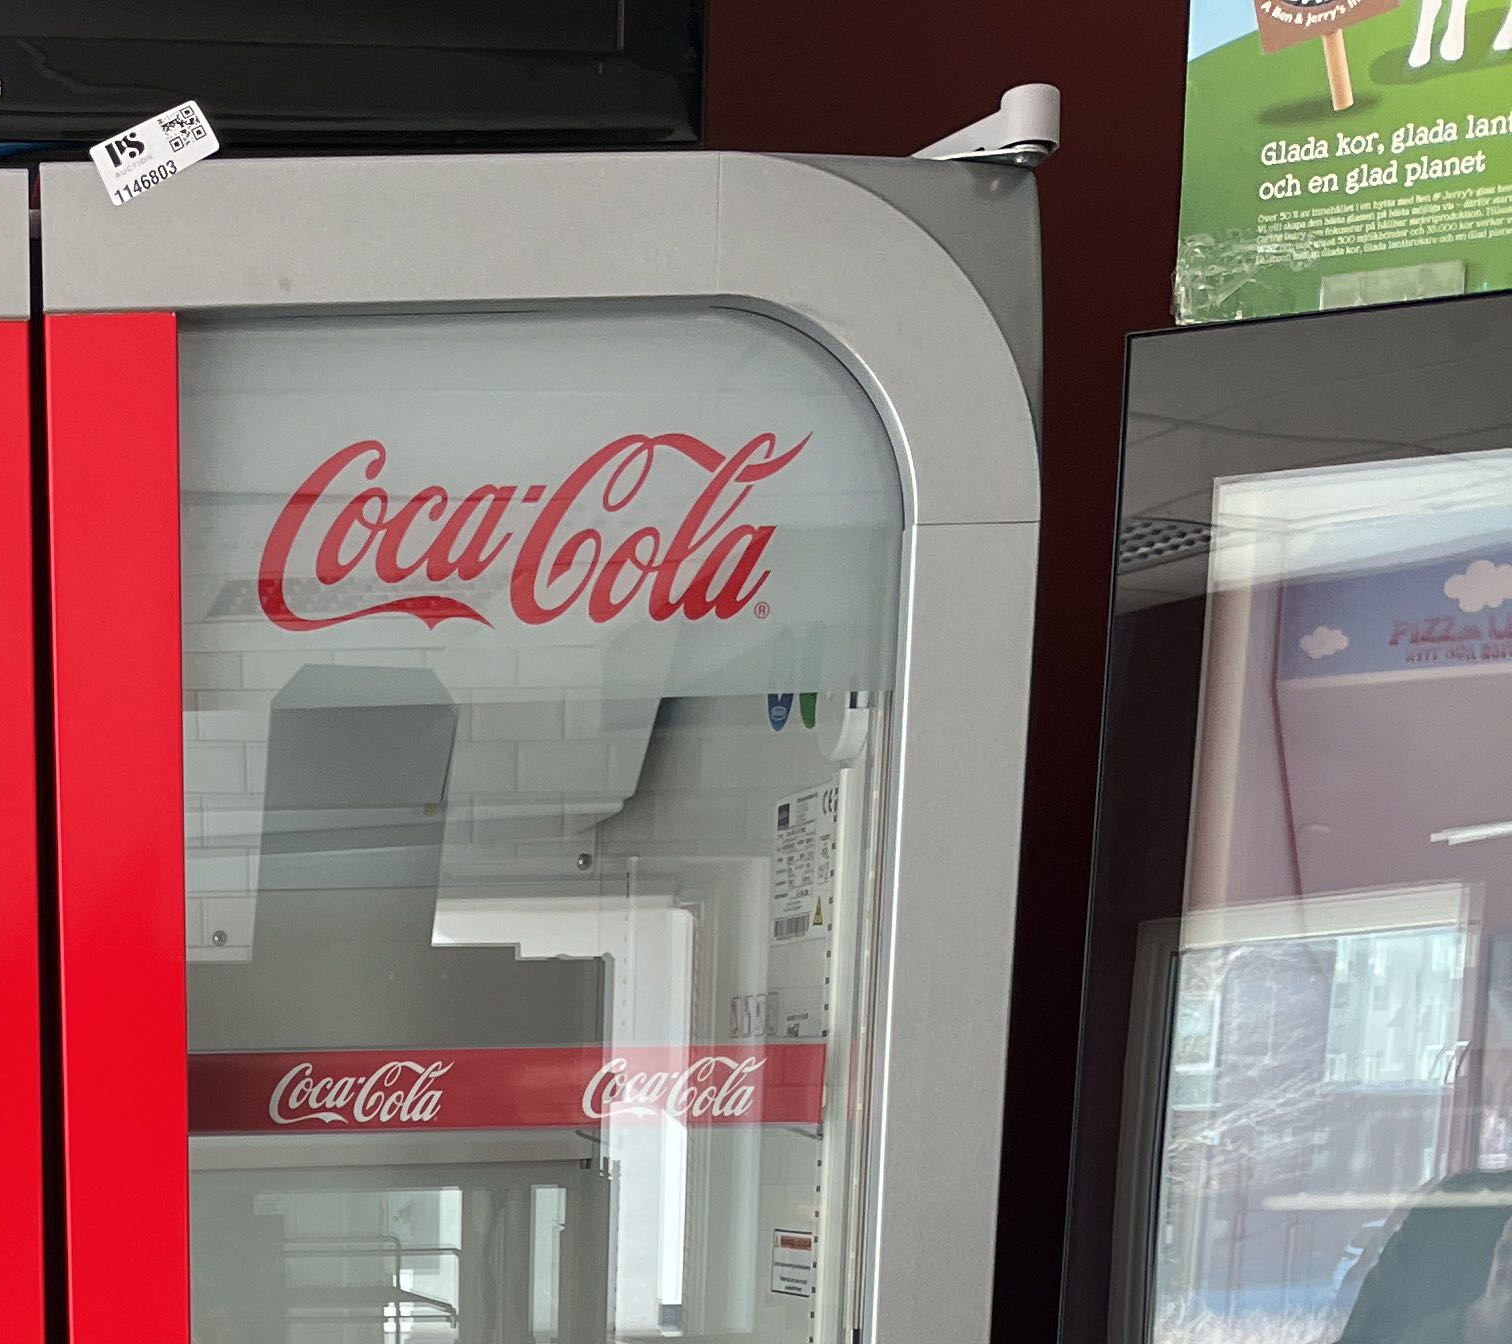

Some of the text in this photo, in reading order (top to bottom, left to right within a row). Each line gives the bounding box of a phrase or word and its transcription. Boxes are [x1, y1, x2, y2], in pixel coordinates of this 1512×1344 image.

[115, 153, 154, 180] AUCTION
[1260, 137, 1330, 166] Glada
[1335, 132, 1386, 155] kor,
[1390, 119, 1458, 154] glada
[113, 159, 178, 203] 1146803
[1259, 150, 1486, 200] och en glad planet
[258, 430, 814, 632] Coca-Cola
[269, 1060, 455, 1124] Coca-Cola
[581, 1055, 768, 1119] Coca-Cola
